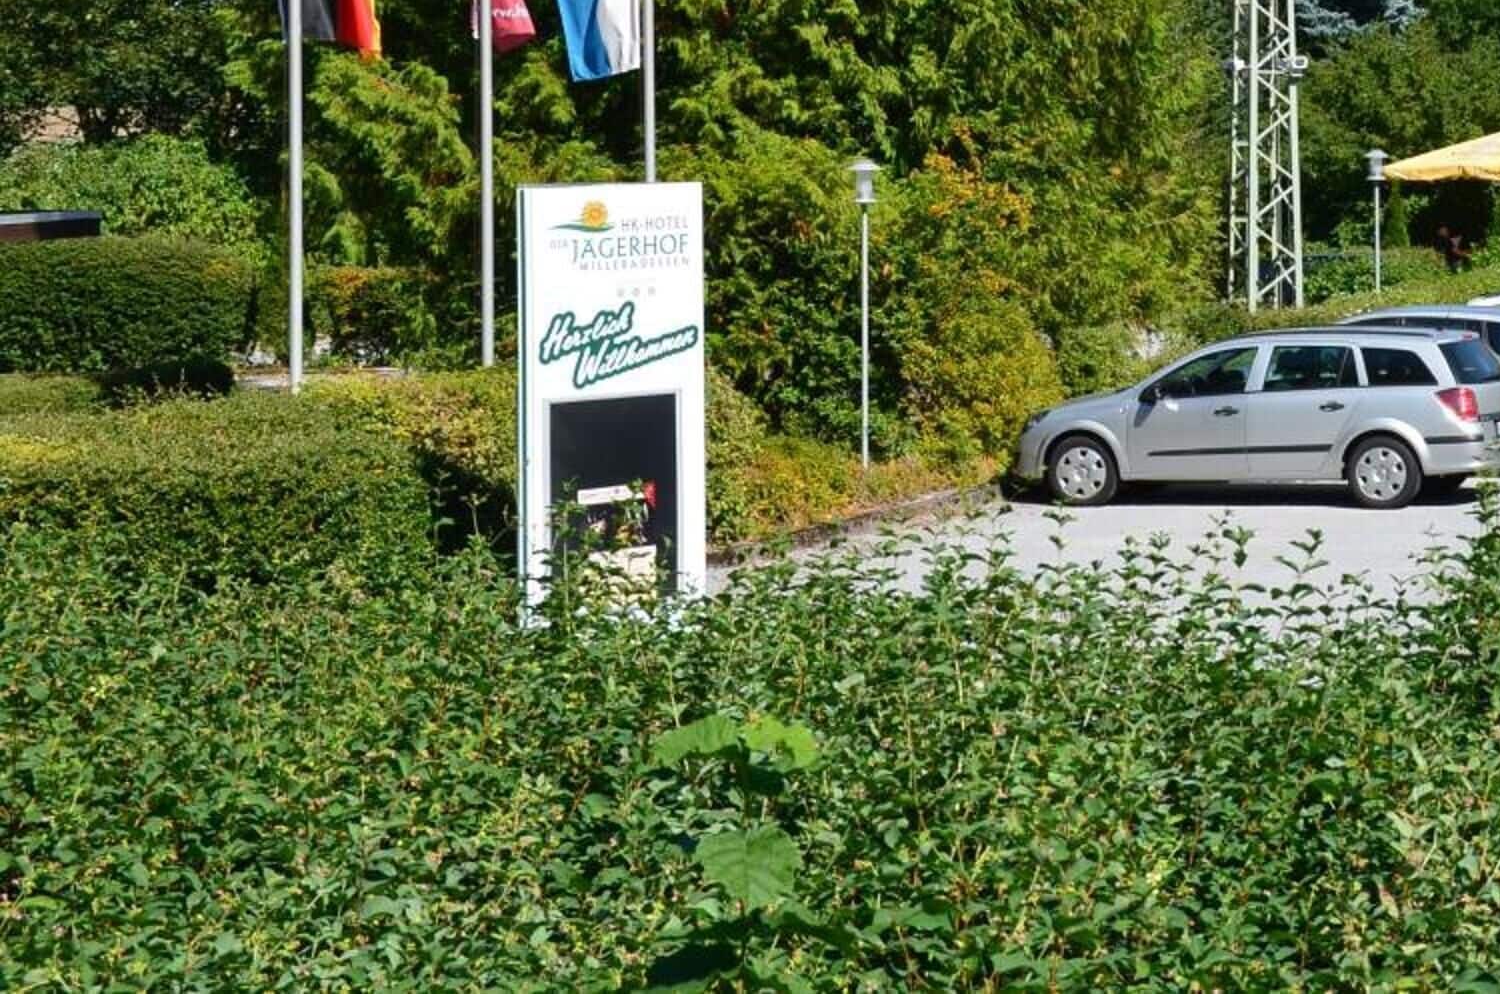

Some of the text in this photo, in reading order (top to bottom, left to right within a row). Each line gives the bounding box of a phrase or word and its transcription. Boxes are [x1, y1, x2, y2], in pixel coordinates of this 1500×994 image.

[620, 215, 689, 232] HK-HOTEL
[570, 233, 689, 263] JÄGERHOF
[541, 301, 634, 363] Herzlich
[574, 325, 698, 388] Willkommen
